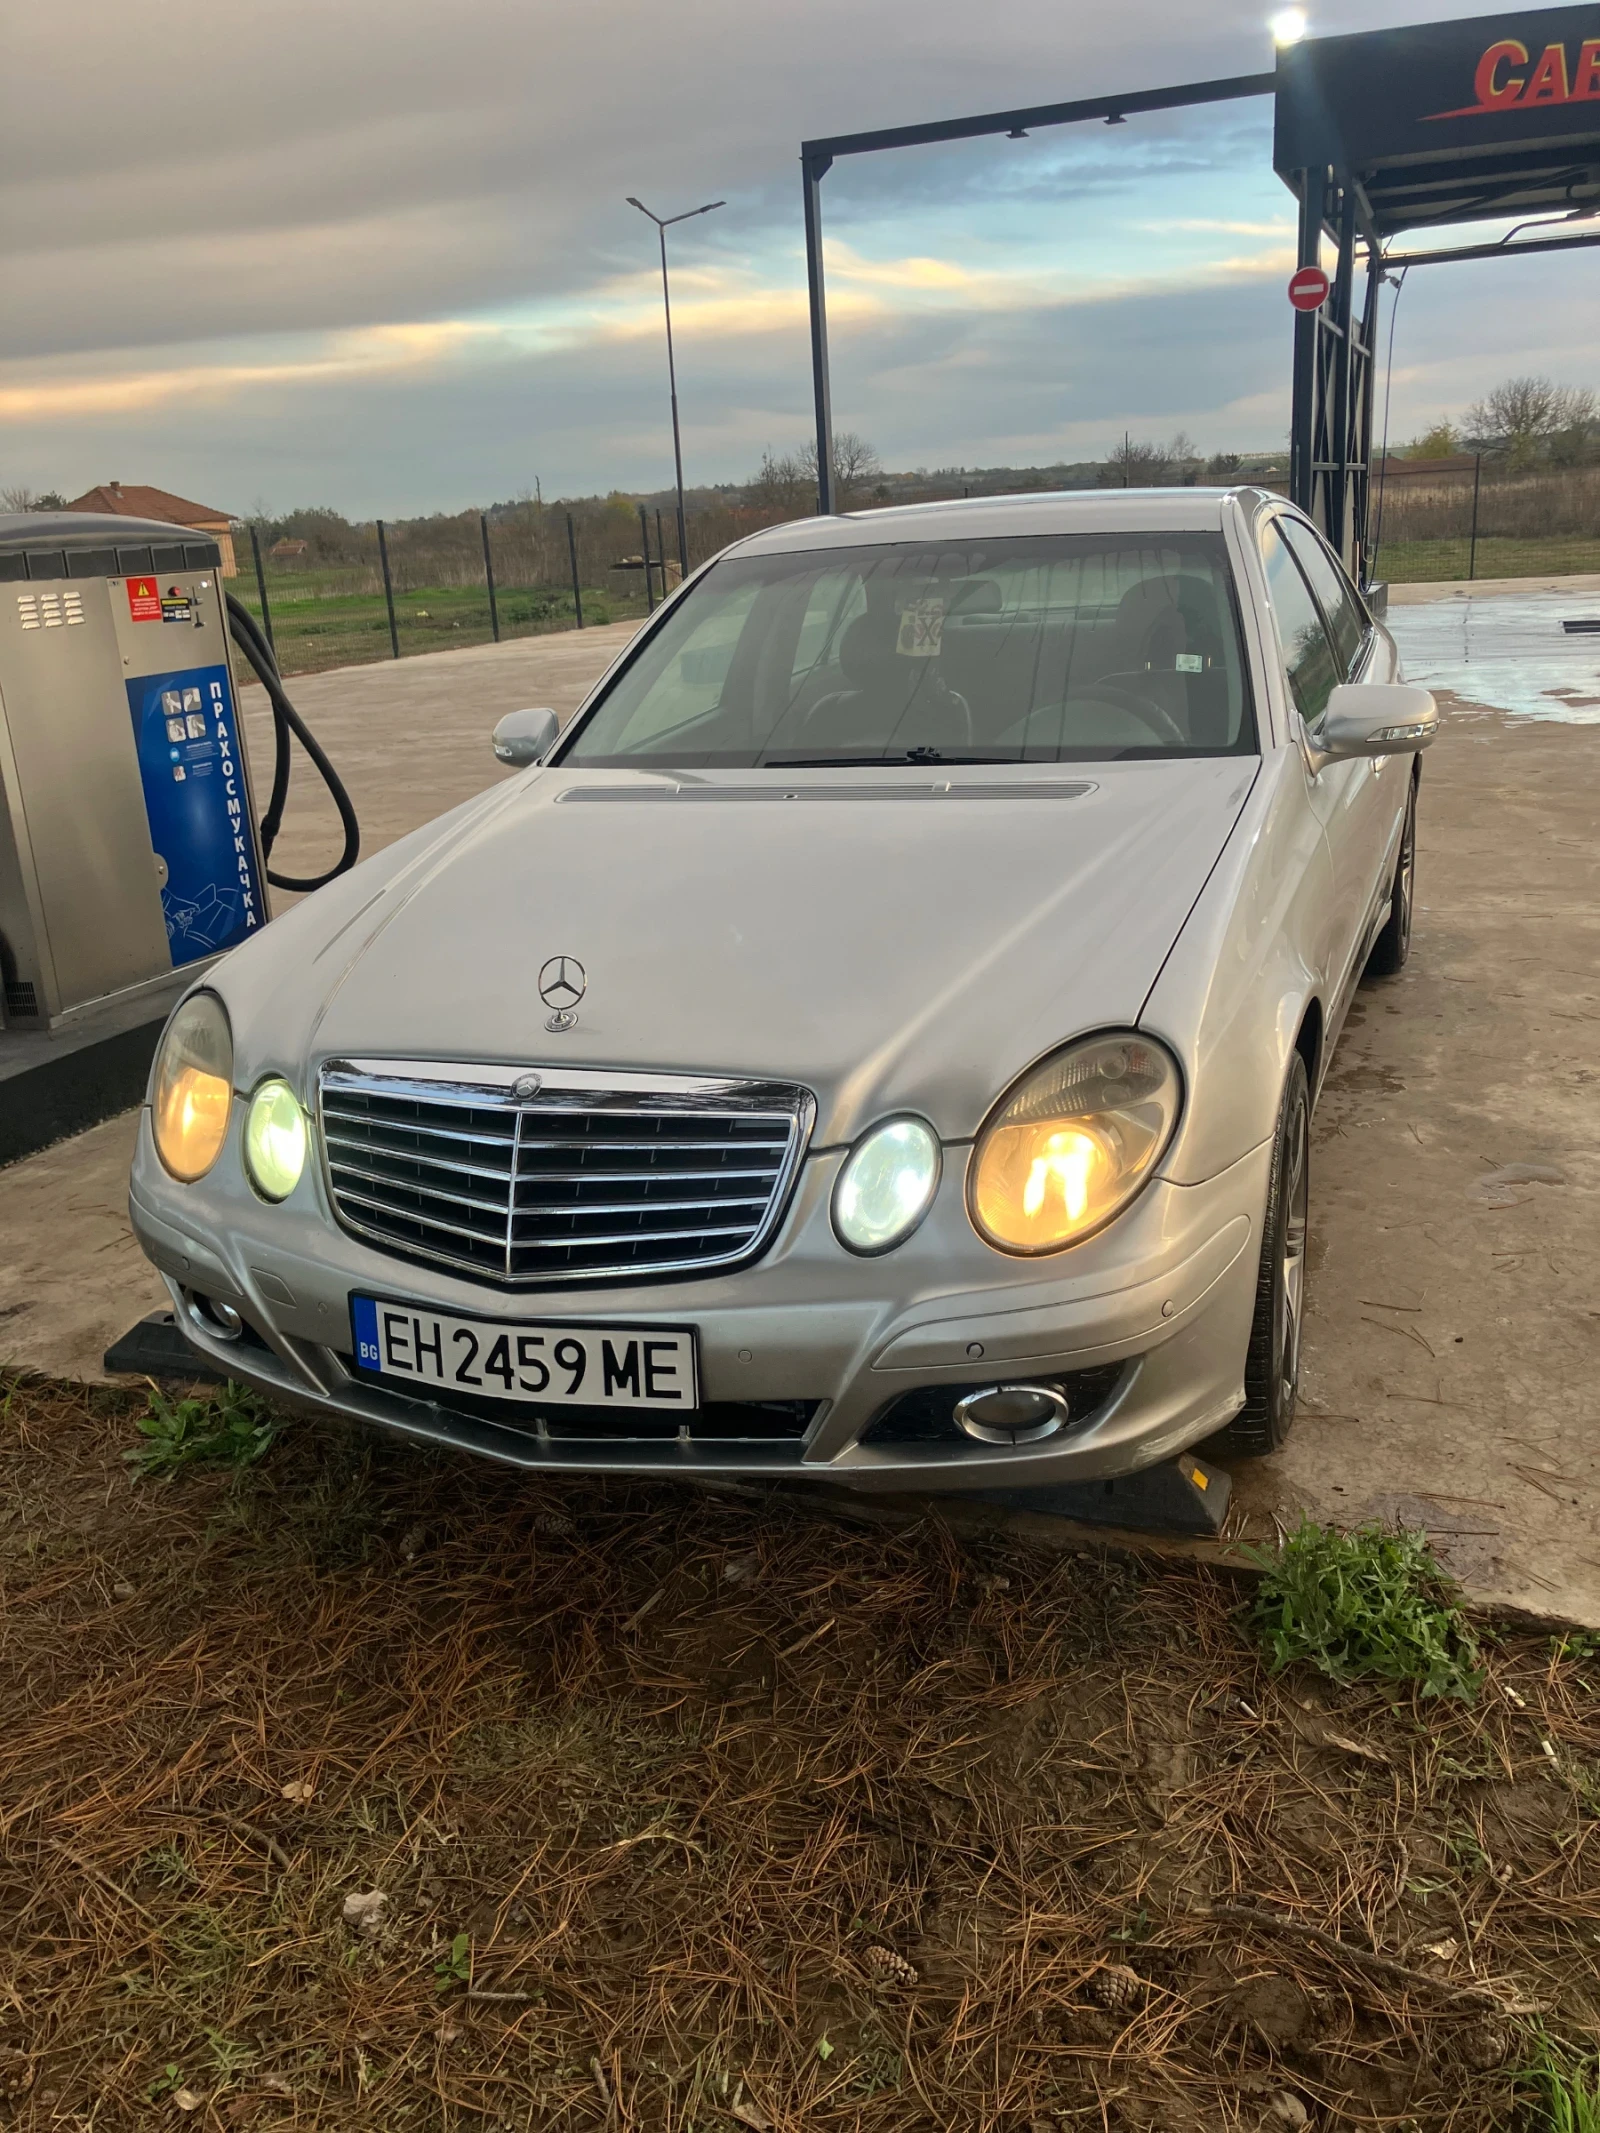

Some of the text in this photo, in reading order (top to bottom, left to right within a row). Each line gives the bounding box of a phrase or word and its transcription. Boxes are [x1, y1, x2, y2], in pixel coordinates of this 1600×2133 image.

[210, 682, 256, 928] ПРАХОСМУКАЧКА
[360, 1341, 378, 1360] BG
[383, 1311, 682, 1399] EH 2459 ME
